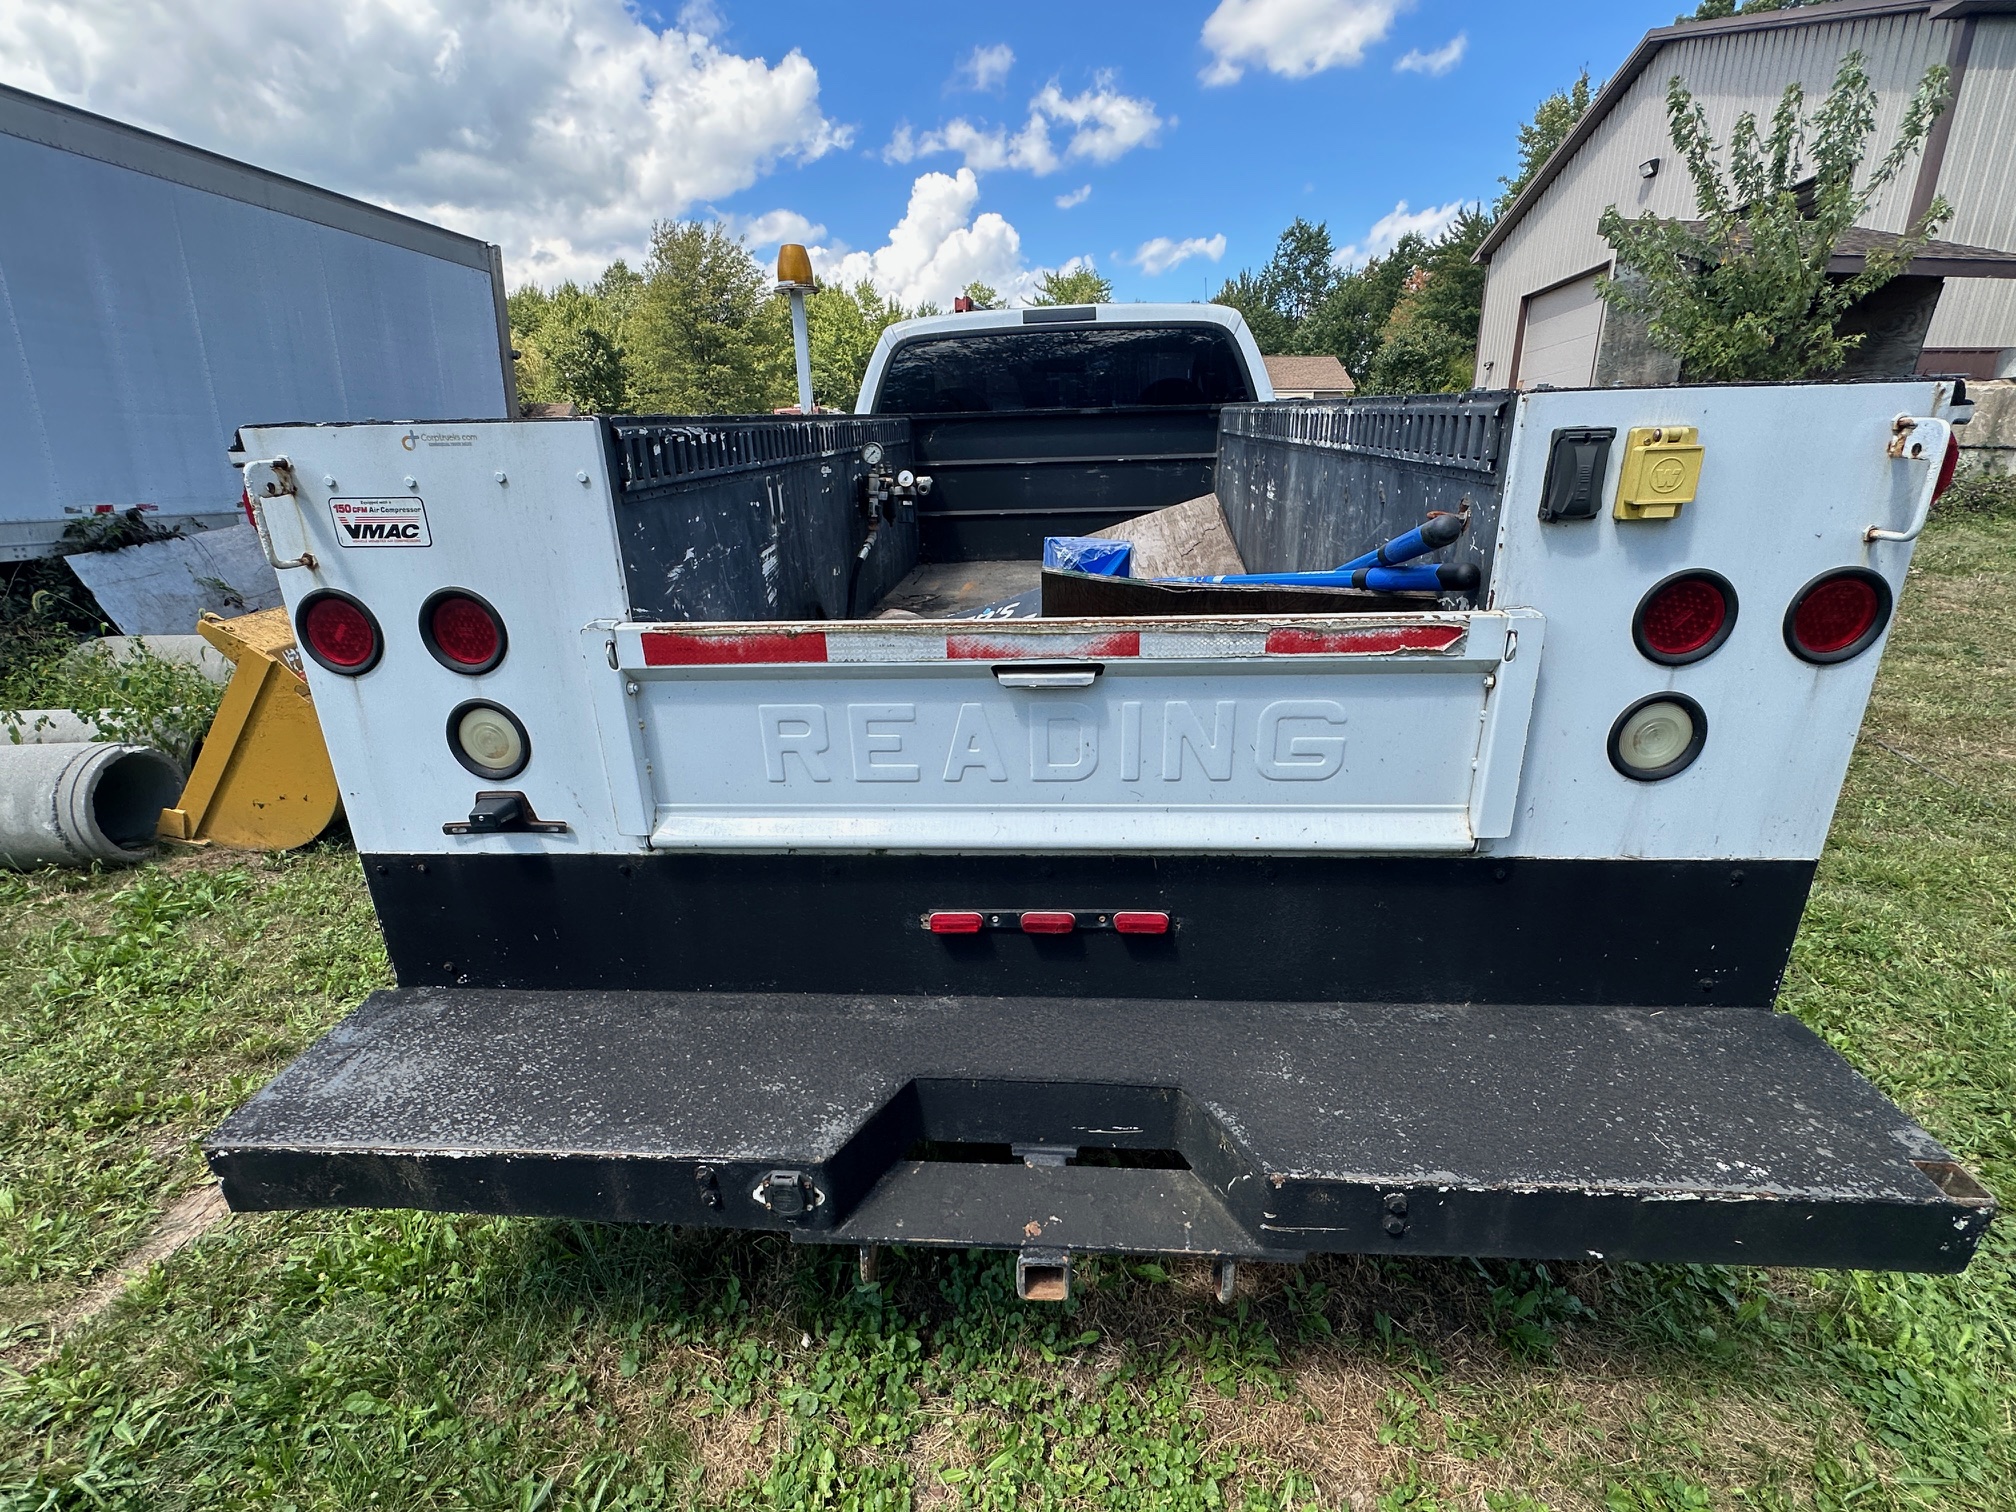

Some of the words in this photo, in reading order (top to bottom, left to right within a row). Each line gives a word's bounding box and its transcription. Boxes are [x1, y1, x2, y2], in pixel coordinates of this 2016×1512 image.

[333, 504, 351, 513] 150
[380, 506, 422, 514] Compressor
[343, 523, 420, 539] VMAC
[758, 700, 1348, 784] READING
